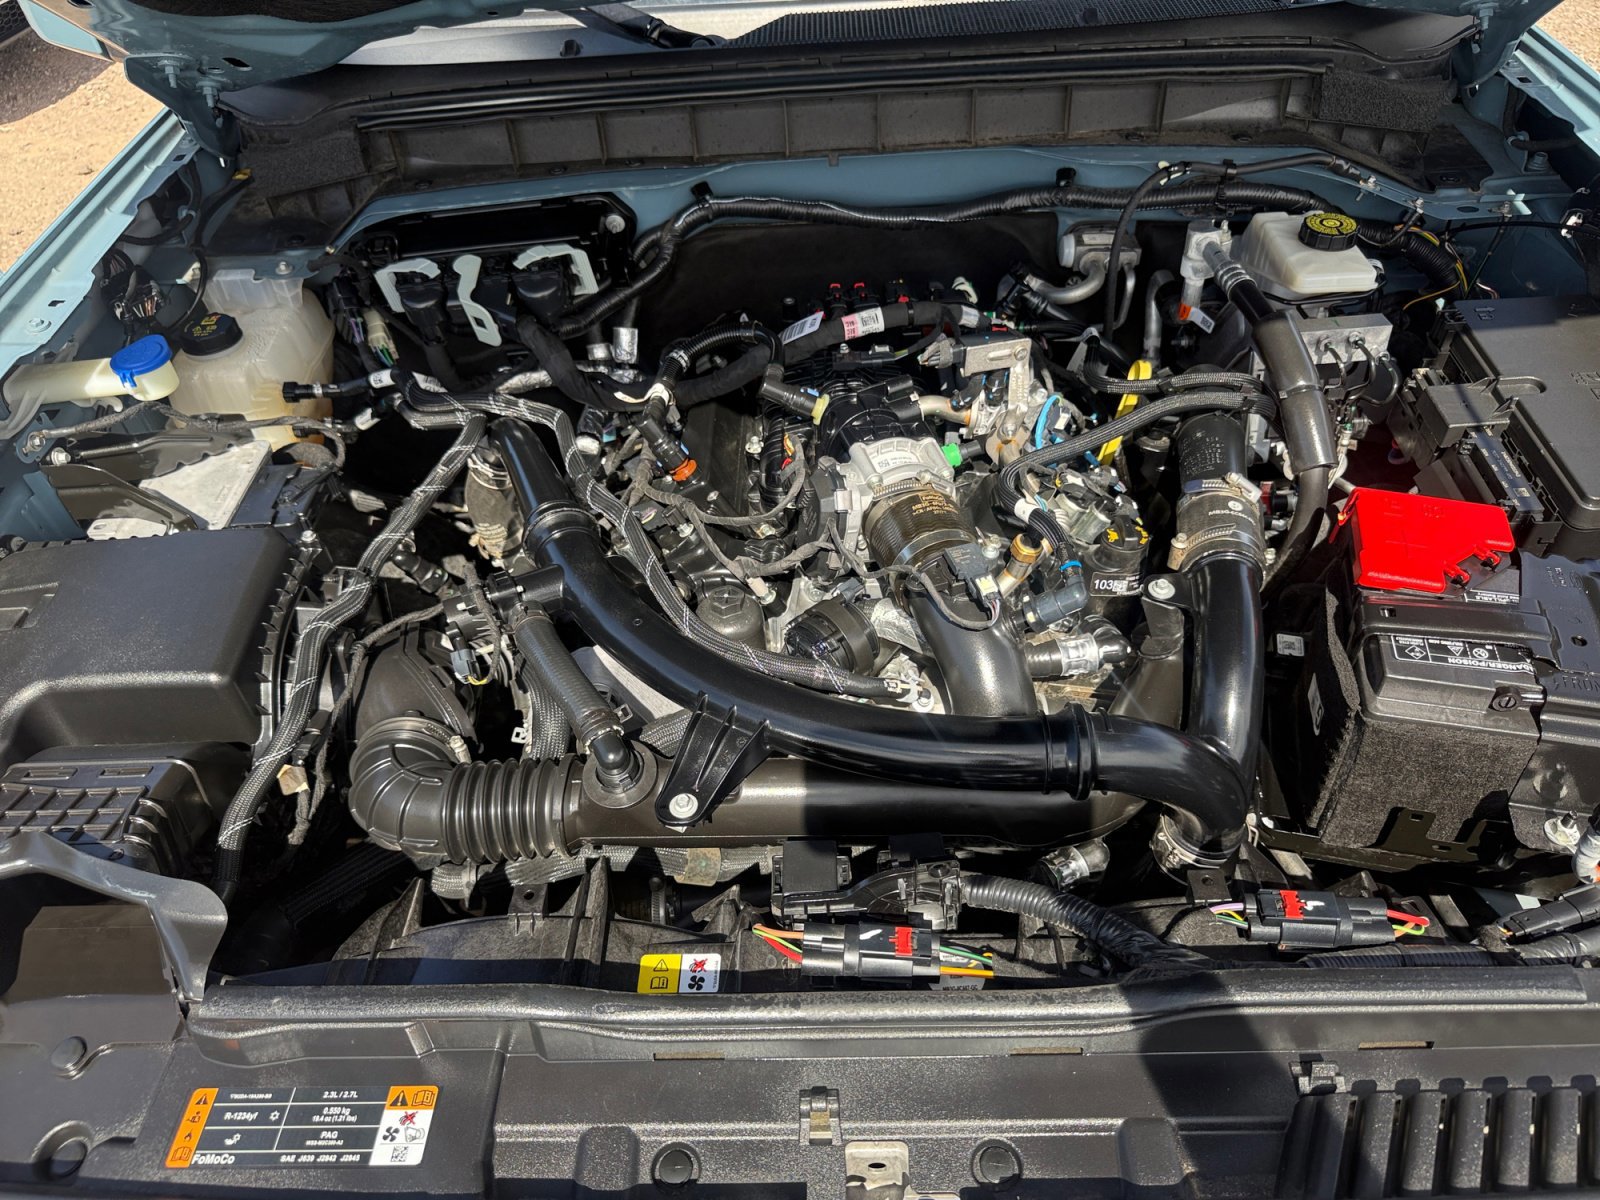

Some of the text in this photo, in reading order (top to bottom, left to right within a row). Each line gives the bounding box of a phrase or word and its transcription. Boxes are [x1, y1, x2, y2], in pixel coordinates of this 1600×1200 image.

[1094, 579, 1113, 590] 103
[323, 1106, 351, 1116] 0.550 kg
[223, 1111, 259, 1122] R-1234yf
[320, 1131, 338, 1139] PAG
[191, 1153, 236, 1165] FoMoCo
[280, 1154, 296, 1162] SAE
[298, 1154, 315, 1162] J639
